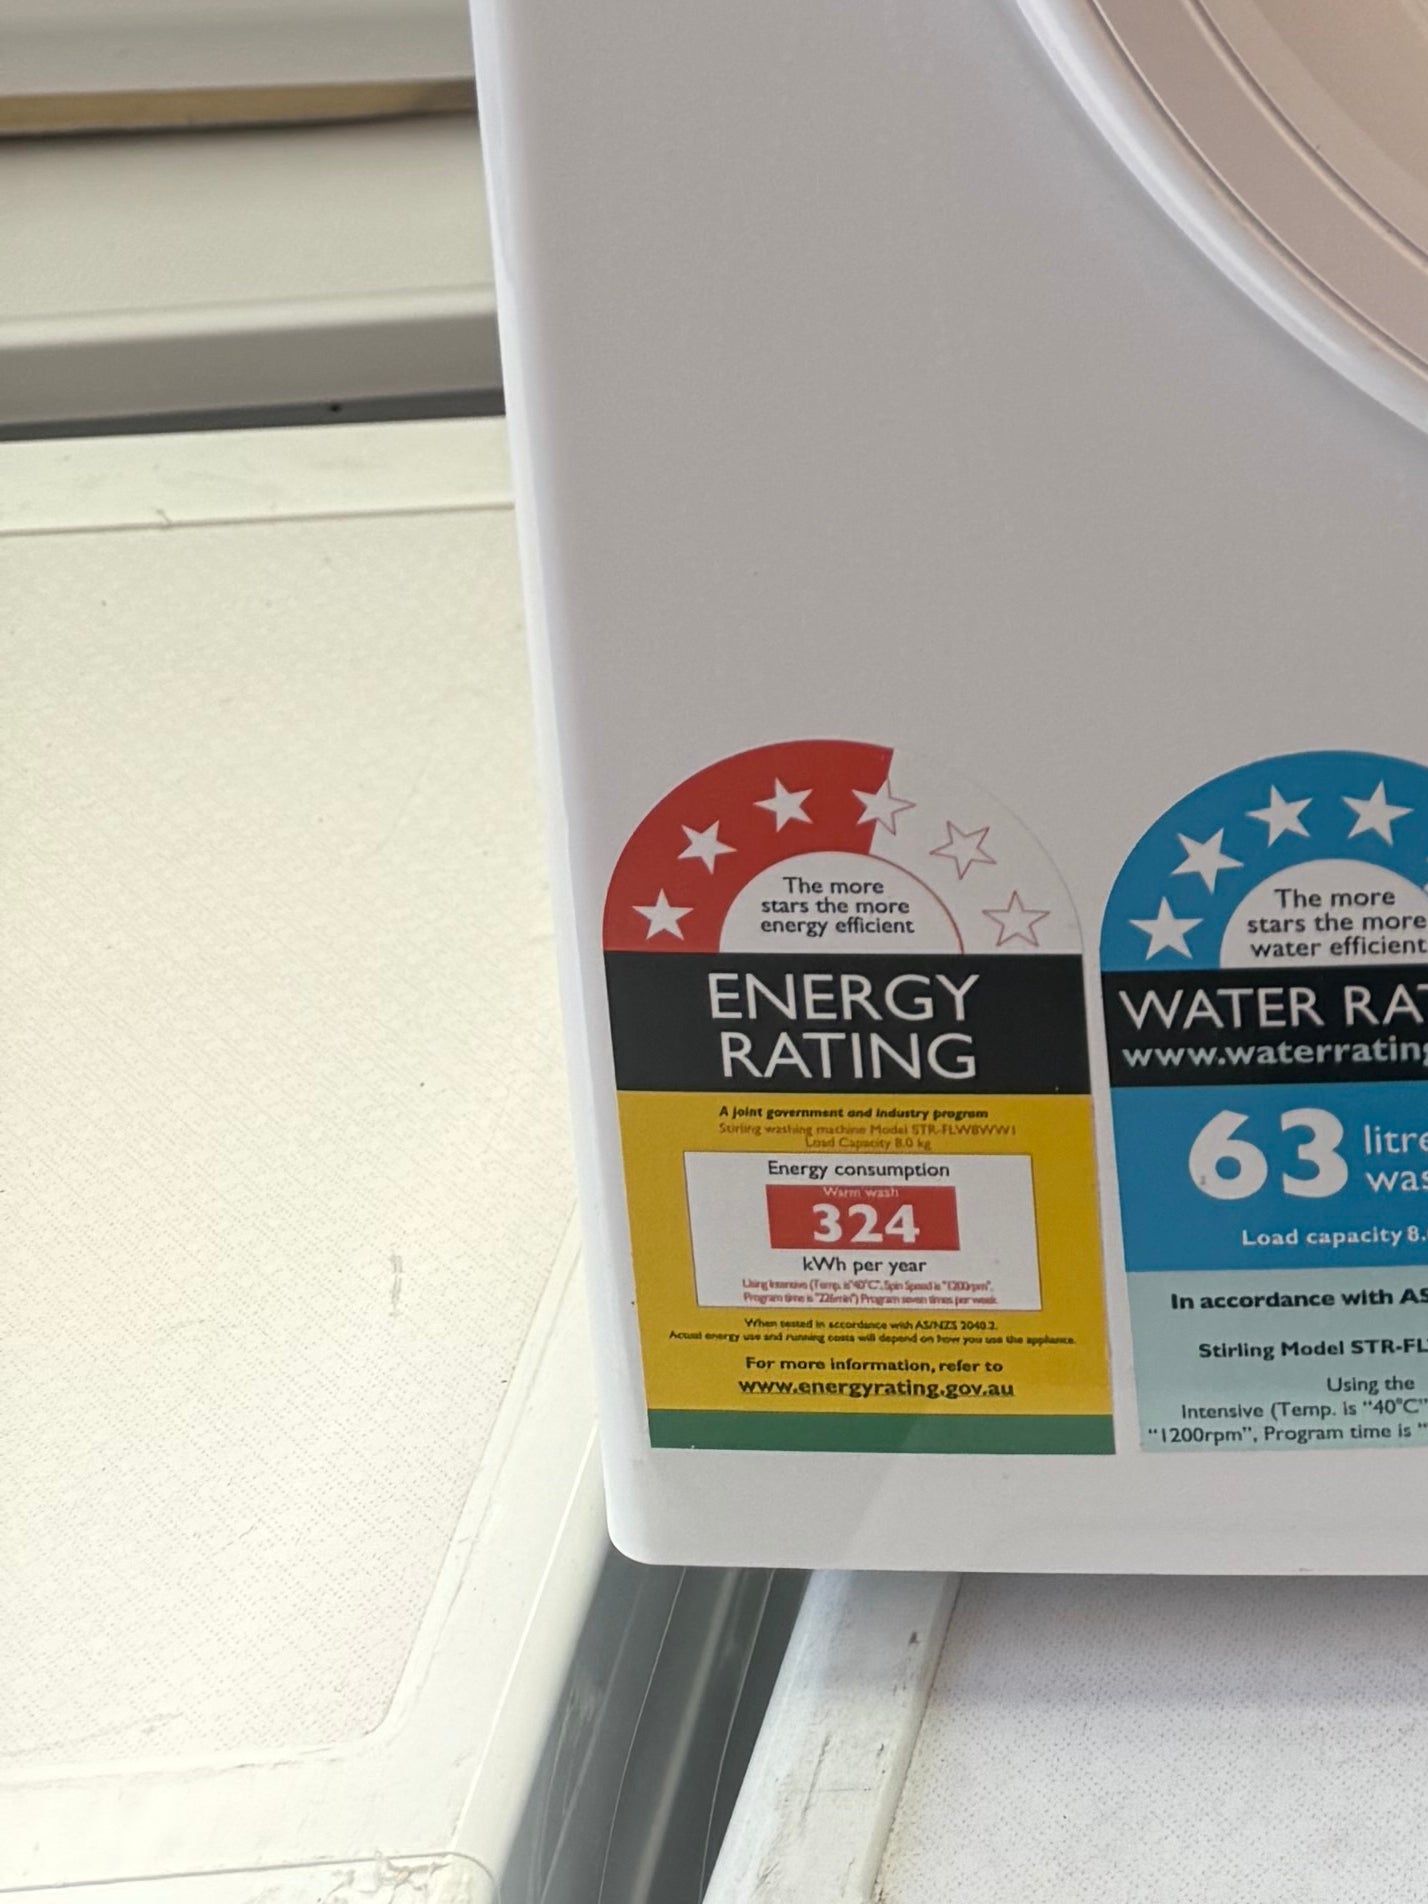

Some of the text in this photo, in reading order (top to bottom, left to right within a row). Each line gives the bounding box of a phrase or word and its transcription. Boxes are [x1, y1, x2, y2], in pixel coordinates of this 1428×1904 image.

[783, 877, 884, 894] The more
[762, 897, 909, 913] stars the more
[1274, 889, 1395, 908] The more
[761, 917, 915, 937] energy efficient
[1248, 912, 1426, 933] stars the more
[1251, 936, 1427, 957] water efficient
[709, 973, 979, 1020] ENERGY
[1119, 987, 1324, 1029] WATER
[721, 1032, 975, 1079] RATING
[719, 1106, 988, 1121] A joint government and industry program
[805, 1137, 931, 1150] Load Capacity 8.0 kg
[1189, 1108, 1348, 1200] 63
[768, 1160, 949, 1180] Energy consumption
[823, 1187, 899, 1198] Warm wash
[812, 1203, 920, 1243] 324
[1243, 1229, 1298, 1245] Load
[1307, 1227, 1402, 1248] capacity
[803, 1256, 927, 1276] kWh per year
[1172, 1294, 1194, 1309] In
[1201, 1292, 1334, 1308] accordance
[1341, 1289, 1393, 1305] with
[1199, 1343, 1274, 1361] Stirling
[1281, 1341, 1344, 1356] Model
[746, 1357, 1003, 1373] For more information, refer to
[739, 1379, 1013, 1399] www.energyrating.gov.au
[1327, 1376, 1414, 1395] Using the
[1182, 1404, 1263, 1419] Intensive
[1271, 1402, 1336, 1421] (Temp.
[1343, 1401, 1356, 1415] is
[1264, 1426, 1343, 1444] Program
[1350, 1425, 1391, 1438] time
[1399, 1424, 1411, 1437] is
